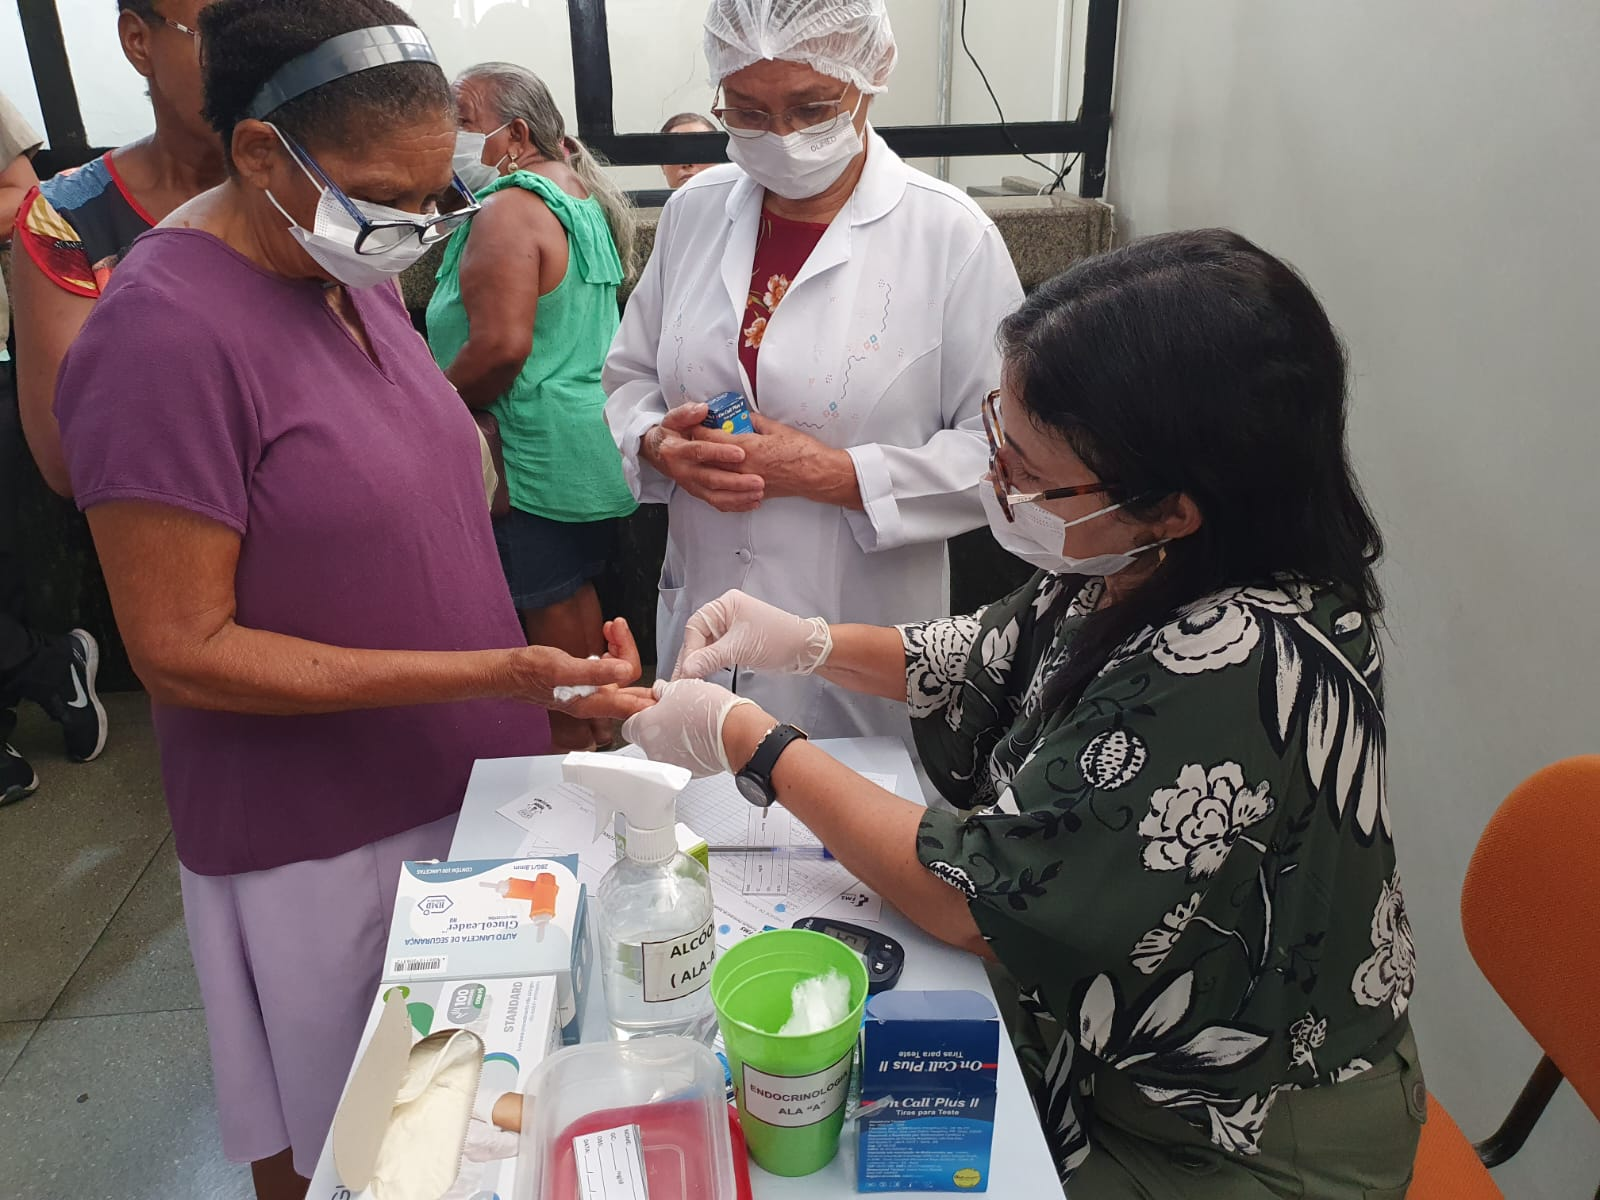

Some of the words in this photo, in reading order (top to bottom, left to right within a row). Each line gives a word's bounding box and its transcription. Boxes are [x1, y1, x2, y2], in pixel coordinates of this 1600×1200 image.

[448, 920, 519, 931] GlucoLeader
[404, 936, 449, 946] SEGURANÇA
[451, 936, 460, 944] DE
[461, 934, 495, 943] LANCETA
[496, 932, 518, 940] AUTO
[670, 923, 715, 959] ALCÓO
[455, 989, 469, 1007] 100
[503, 981, 523, 1033] STANDARD
[879, 1060, 888, 1072] II
[892, 1060, 924, 1072] Plus
[928, 1060, 957, 1072] Call
[960, 1060, 983, 1071] On
[750, 1071, 848, 1102] ENDOCRINOLOGIA
[902, 1097, 930, 1108] Call
[934, 1097, 966, 1108] Plus
[969, 1097, 980, 1108] II
